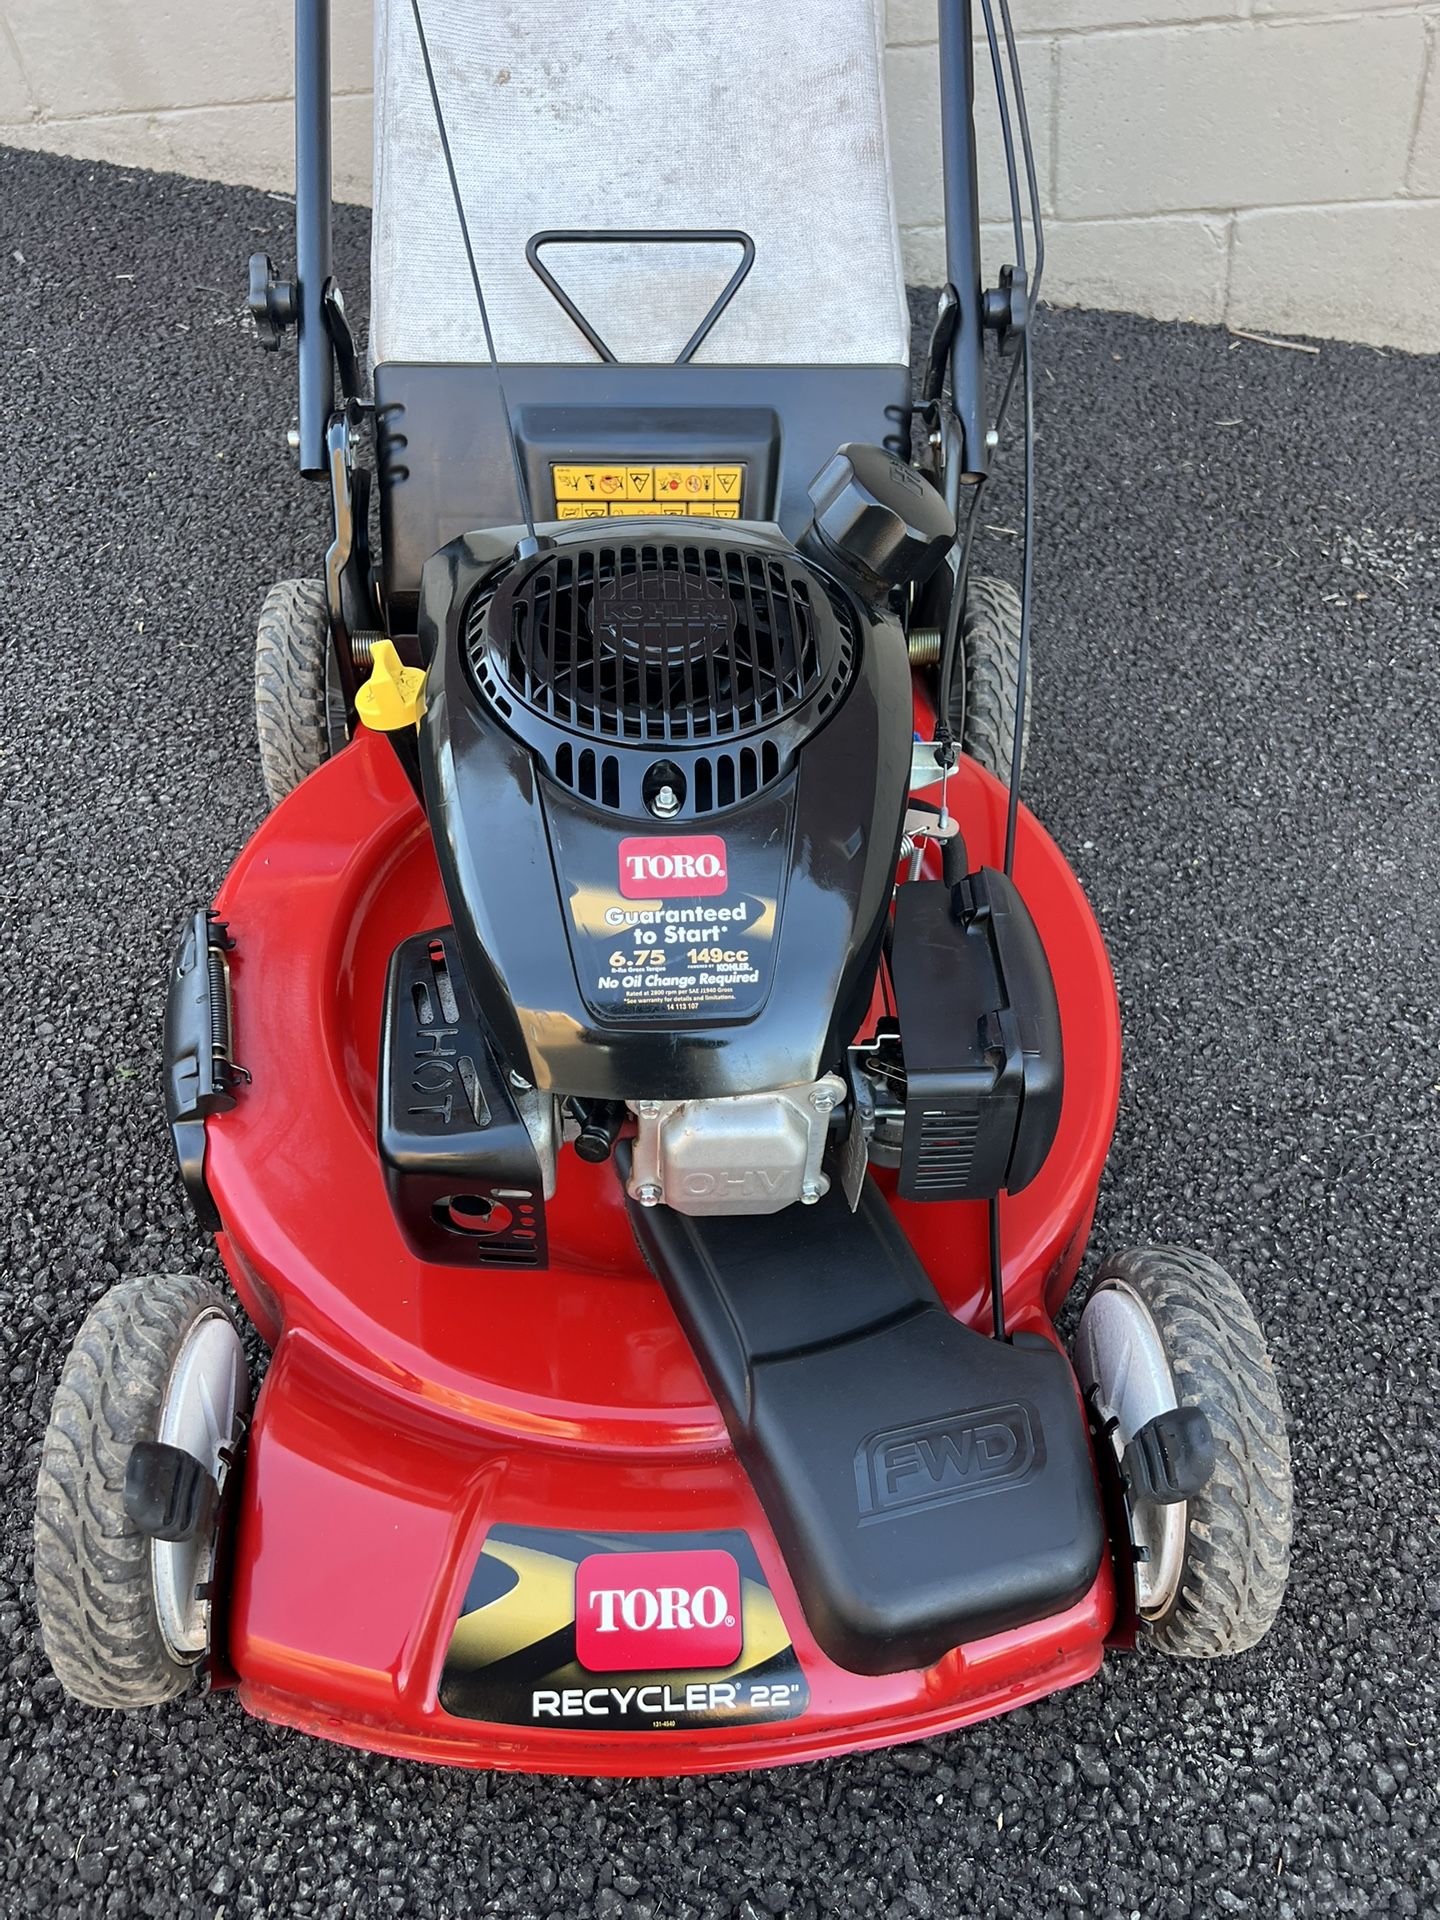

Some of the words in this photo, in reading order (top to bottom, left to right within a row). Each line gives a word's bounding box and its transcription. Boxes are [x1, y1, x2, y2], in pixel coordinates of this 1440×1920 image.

[605, 902, 747, 926] Guaranteed
[633, 929, 658, 945] to
[608, 949, 667, 967] 6.75
[686, 947, 750, 965] 149cc
[598, 976, 619, 989] No
[622, 974, 643, 989] Oil
[645, 973, 697, 989] Change
[699, 969, 760, 987] Required
[687, 1002, 699, 1010] 107
[408, 1028, 460, 1124] HOT
[683, 1171, 792, 1197] OHV
[884, 1423, 1018, 1494] FWD
[750, 1684, 800, 1708] 22"
